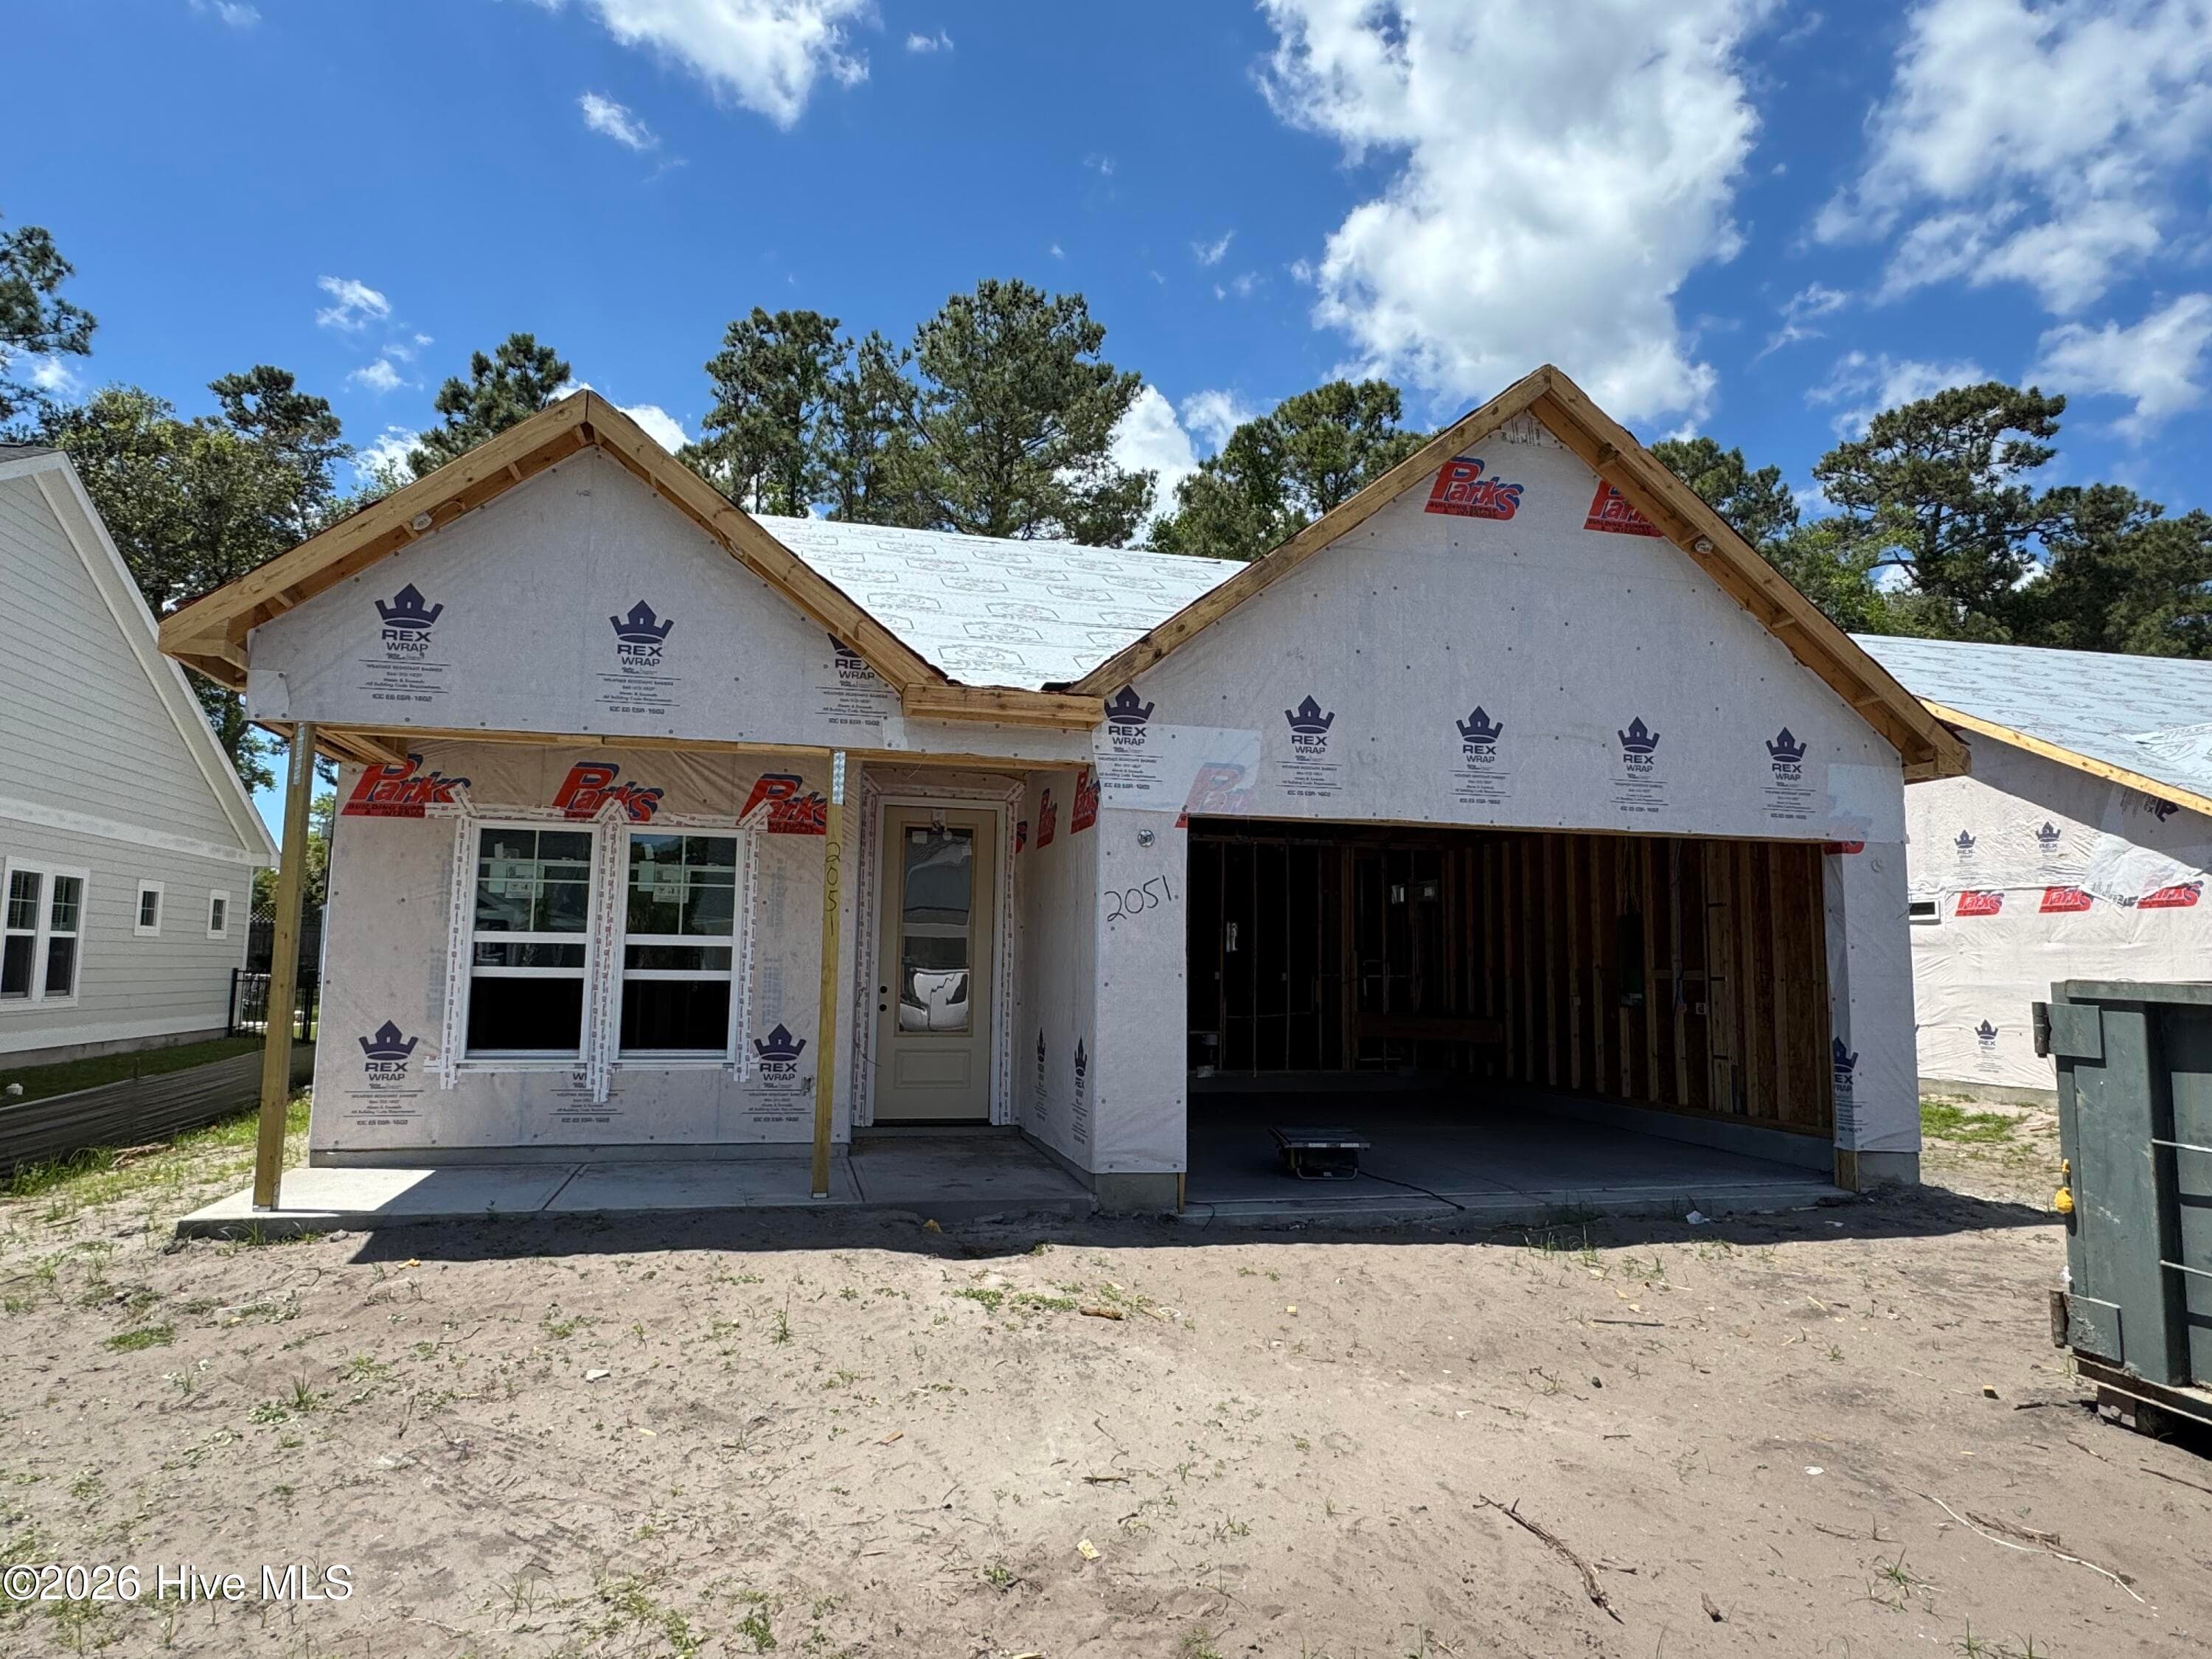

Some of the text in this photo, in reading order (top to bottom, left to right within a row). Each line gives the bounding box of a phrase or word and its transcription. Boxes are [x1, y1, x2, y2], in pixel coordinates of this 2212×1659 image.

[1429, 456, 1524, 521] Parks
[1587, 479, 1652, 524] Par
[382, 629, 431, 642] REX
[386, 642, 428, 652] WRAP
[617, 644, 662, 657] REX
[622, 656, 660, 667] WRAP
[839, 670, 875, 680] WRAP
[1108, 726, 1147, 737] REX
[1112, 737, 1145, 745] WRAP
[1291, 734, 1328, 746] REX
[1295, 746, 1326, 755] WRAP
[1462, 745, 1497, 755] REX
[1467, 755, 1495, 763] WRAP
[1623, 754, 1655, 765] REX
[1627, 765, 1653, 773] WRAP
[1772, 762, 1803, 773] REX
[1775, 773, 1801, 781] WRAP
[552, 762, 664, 821] Parks
[826, 841, 841, 936] 2051
[1105, 874, 1172, 922] 2051
[364, 1062, 408, 1072] REX
[760, 1062, 798, 1072] REX
[369, 1073, 406, 1081] WRAP
[763, 1073, 796, 1081] WRAP
[1834, 1074, 1853, 1085] EX
